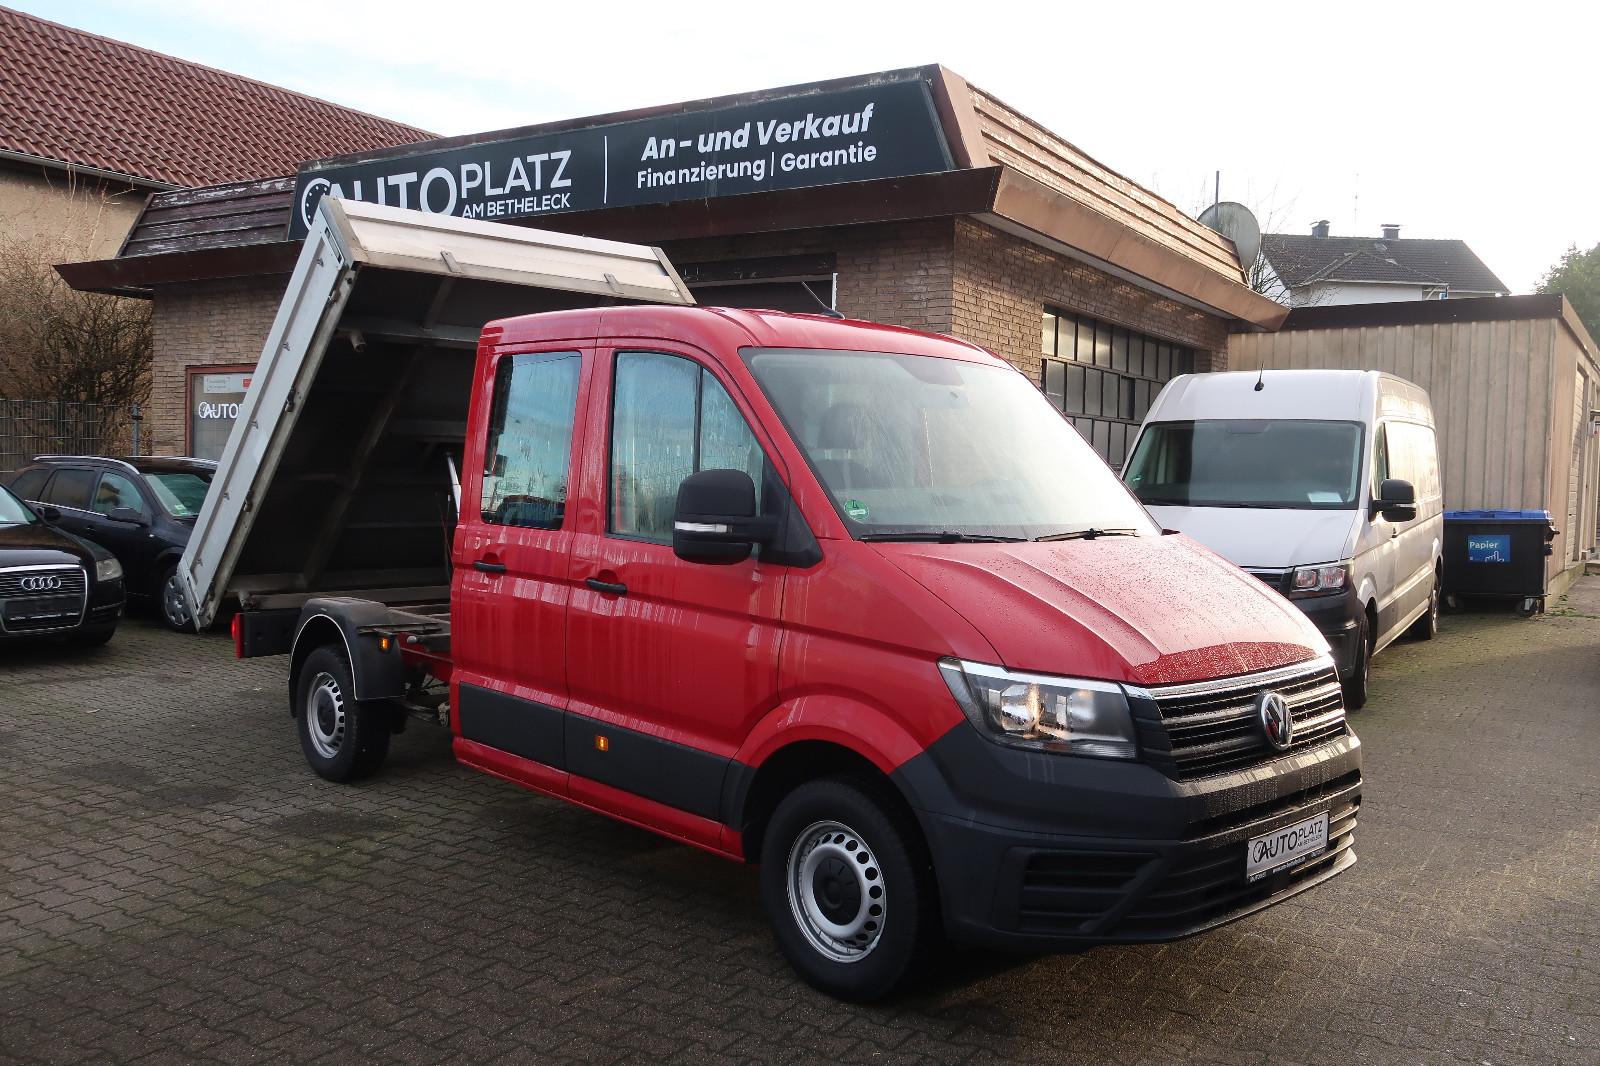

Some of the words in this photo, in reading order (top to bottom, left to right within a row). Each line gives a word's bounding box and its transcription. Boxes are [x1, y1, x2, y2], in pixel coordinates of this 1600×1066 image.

[698, 122, 750, 153] und
[757, 103, 874, 145] Verkauf
[637, 158, 766, 189] Finanzierung
[781, 141, 877, 172] Garantie
[463, 203, 485, 218] AM
[486, 193, 571, 217] BETHELECK
[1469, 540, 1499, 550] Papier
[1258, 820, 1323, 863] AUTOPLATZ
